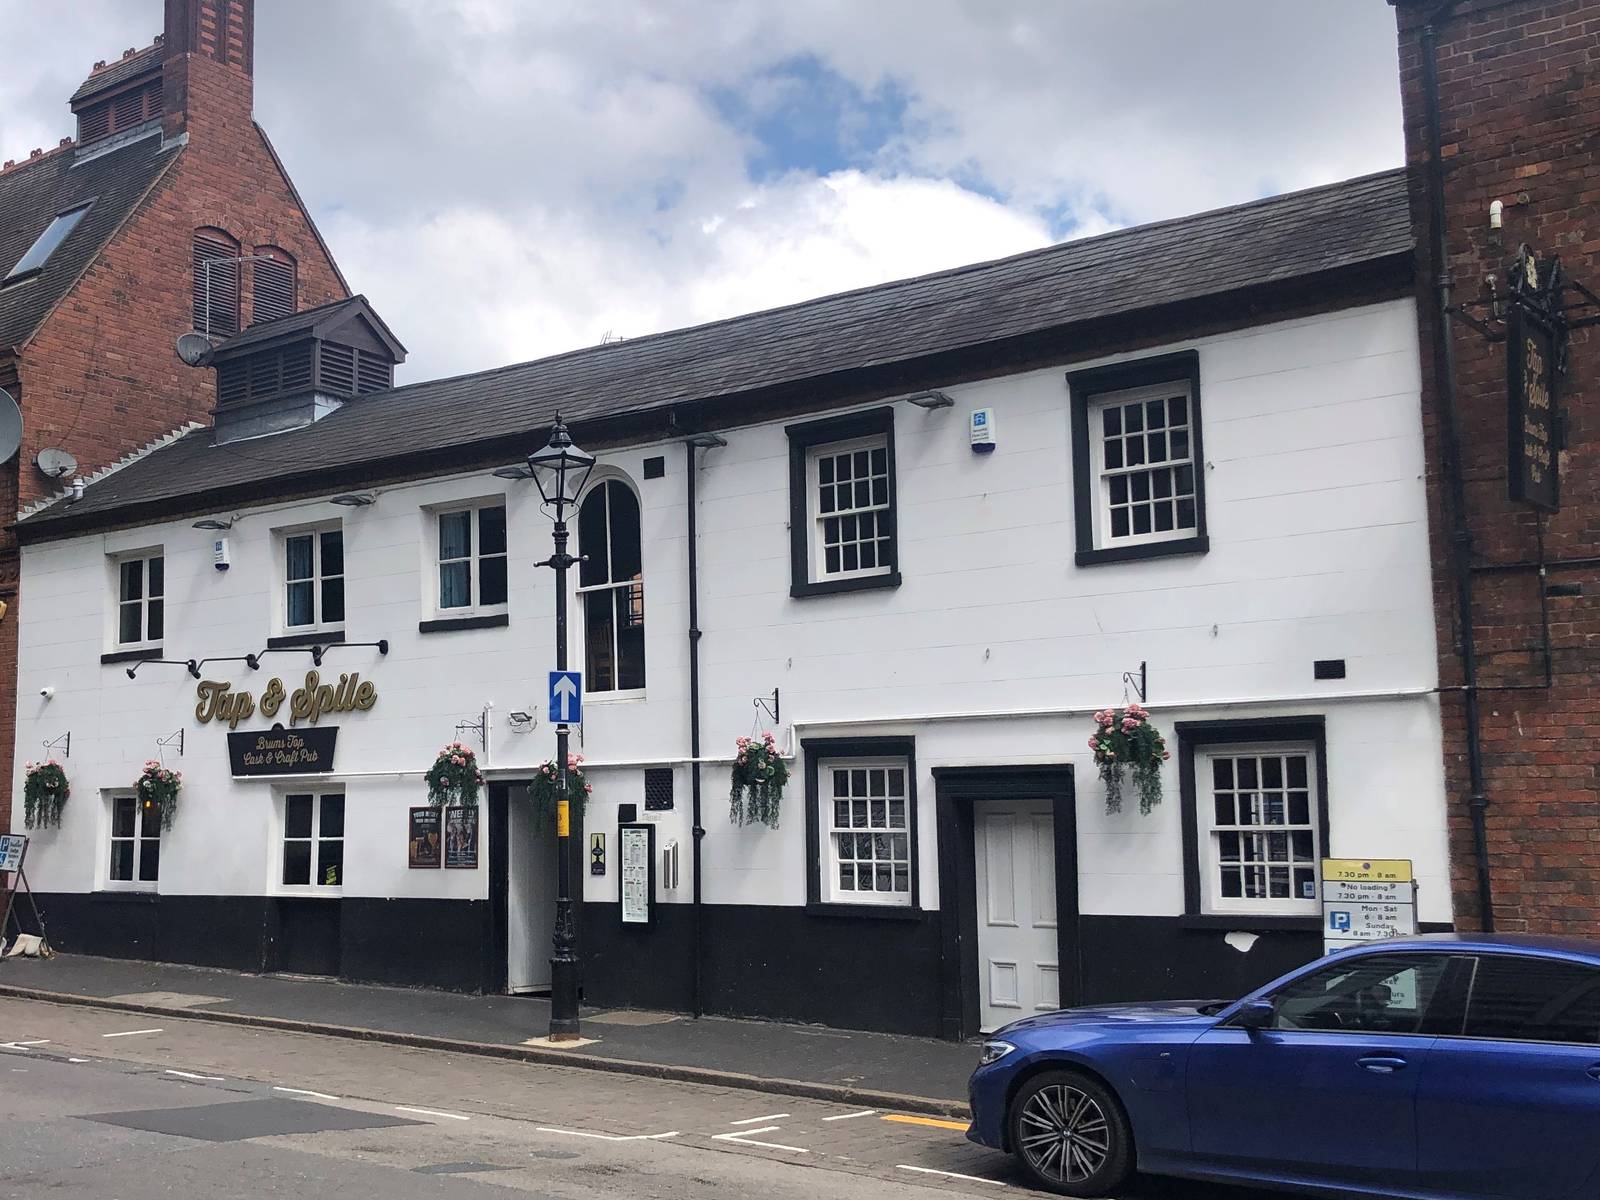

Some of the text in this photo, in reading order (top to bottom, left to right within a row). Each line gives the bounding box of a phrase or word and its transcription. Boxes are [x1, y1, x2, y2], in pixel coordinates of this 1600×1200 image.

[195, 670, 377, 729] Tap & Spile
[256, 734, 304, 750] Brums Top
[243, 748, 318, 767] Cask & Craft Pub
